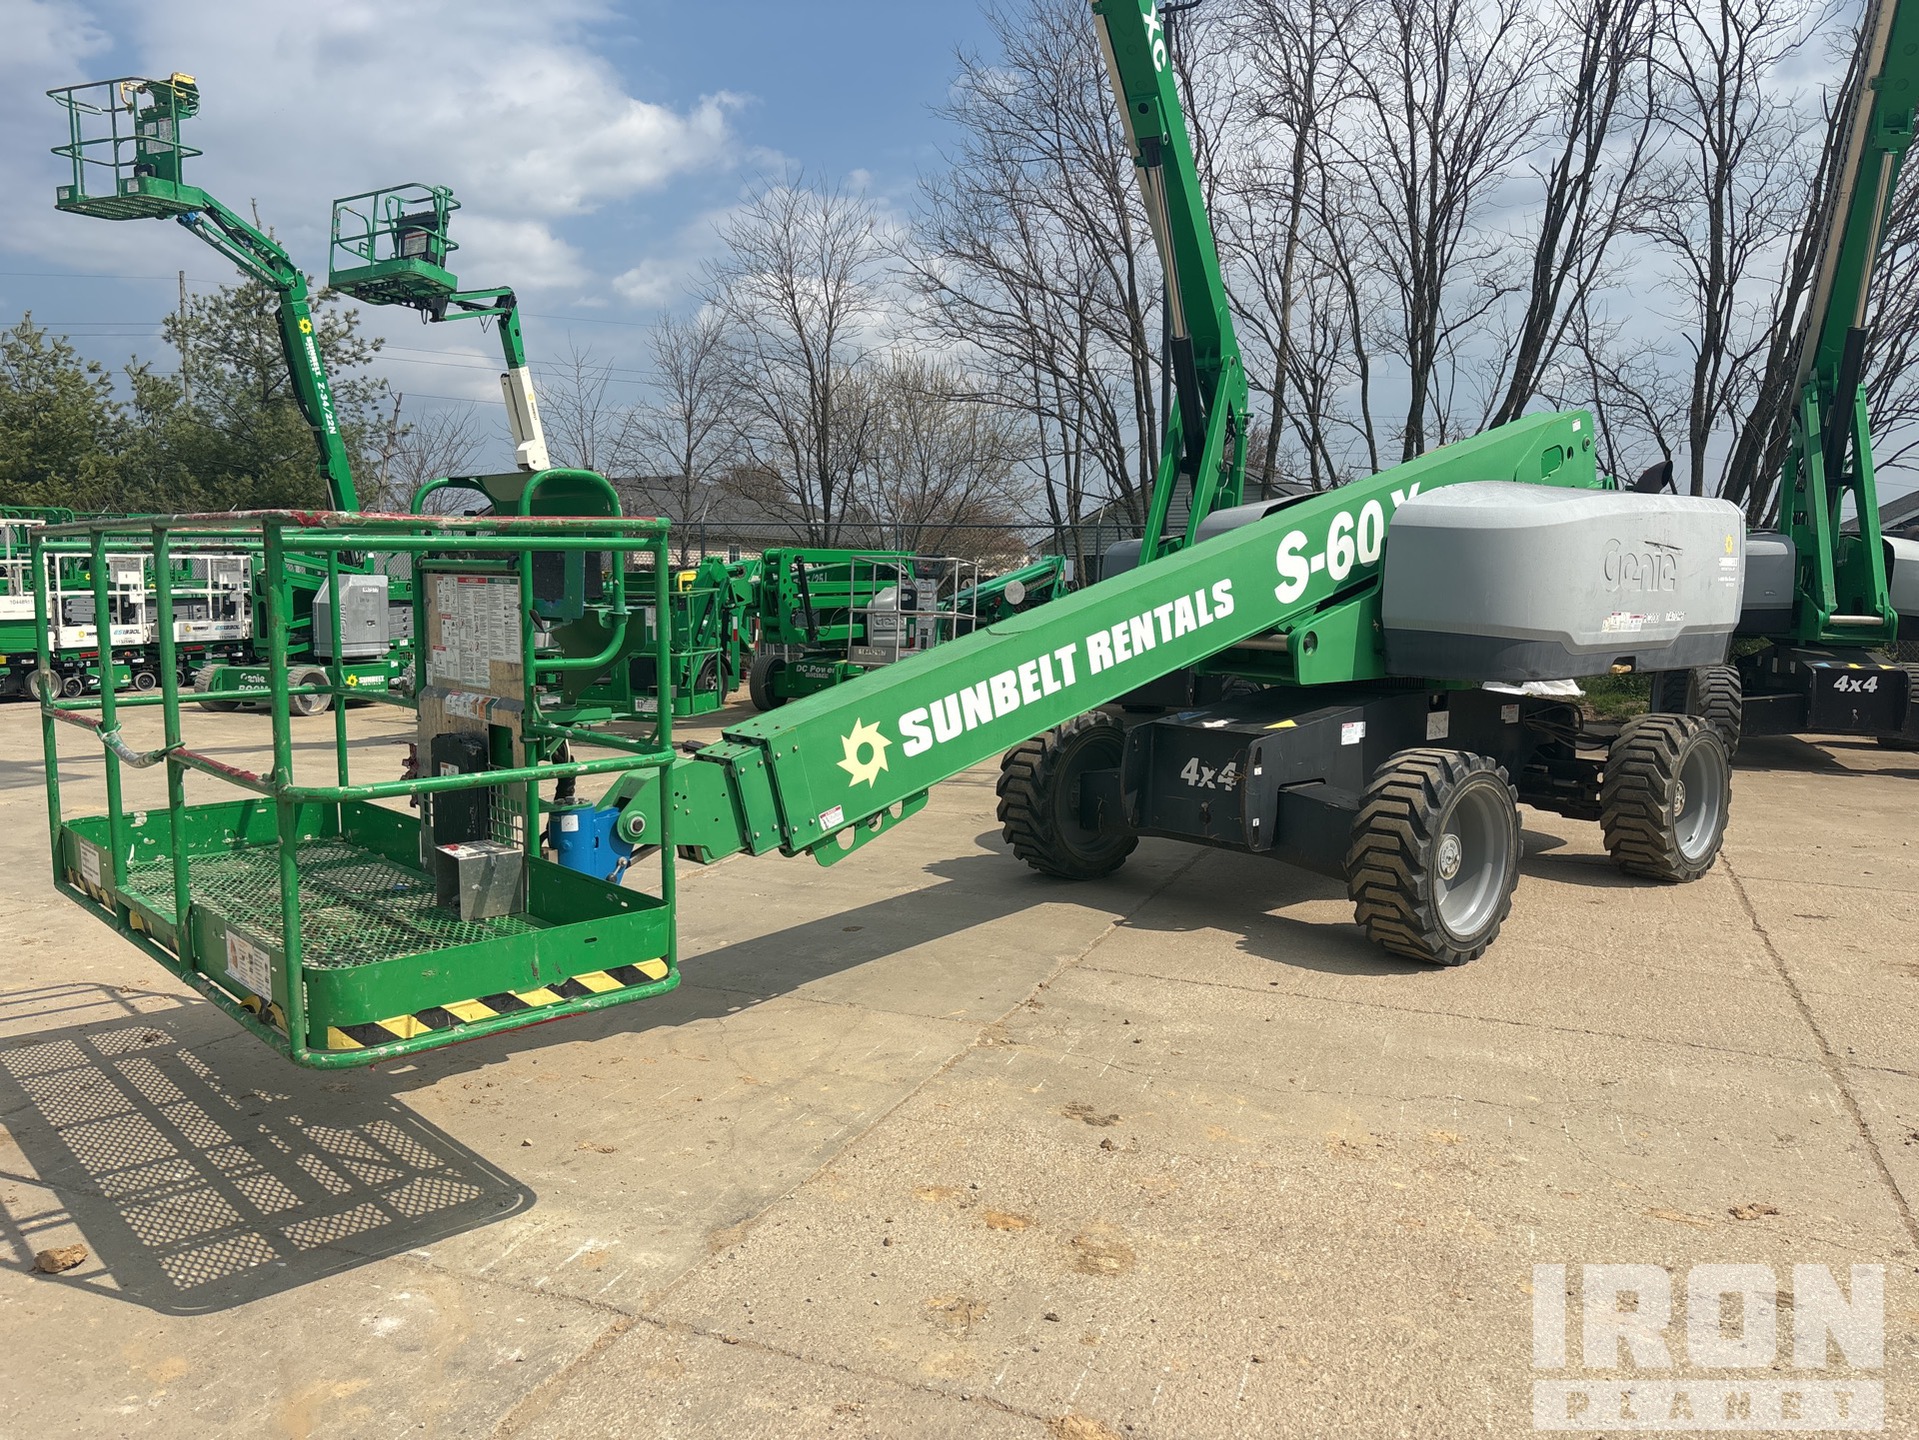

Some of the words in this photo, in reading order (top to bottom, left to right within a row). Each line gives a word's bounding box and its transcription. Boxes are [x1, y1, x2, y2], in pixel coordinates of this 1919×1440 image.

[1143, 2, 1167, 73] XC
[305, 335, 321, 376] SUNBELT
[317, 382, 337, 434] Z-34/22N
[1605, 538, 1676, 592] Genie
[358, 675, 385, 683] SUNBELT
[796, 664, 809, 673] DC
[898, 642, 1077, 757] SUNBELT
[1086, 578, 1234, 675] RENTALS
[1833, 674, 1878, 693] 4x4
[1180, 757, 1237, 792] 4x4
